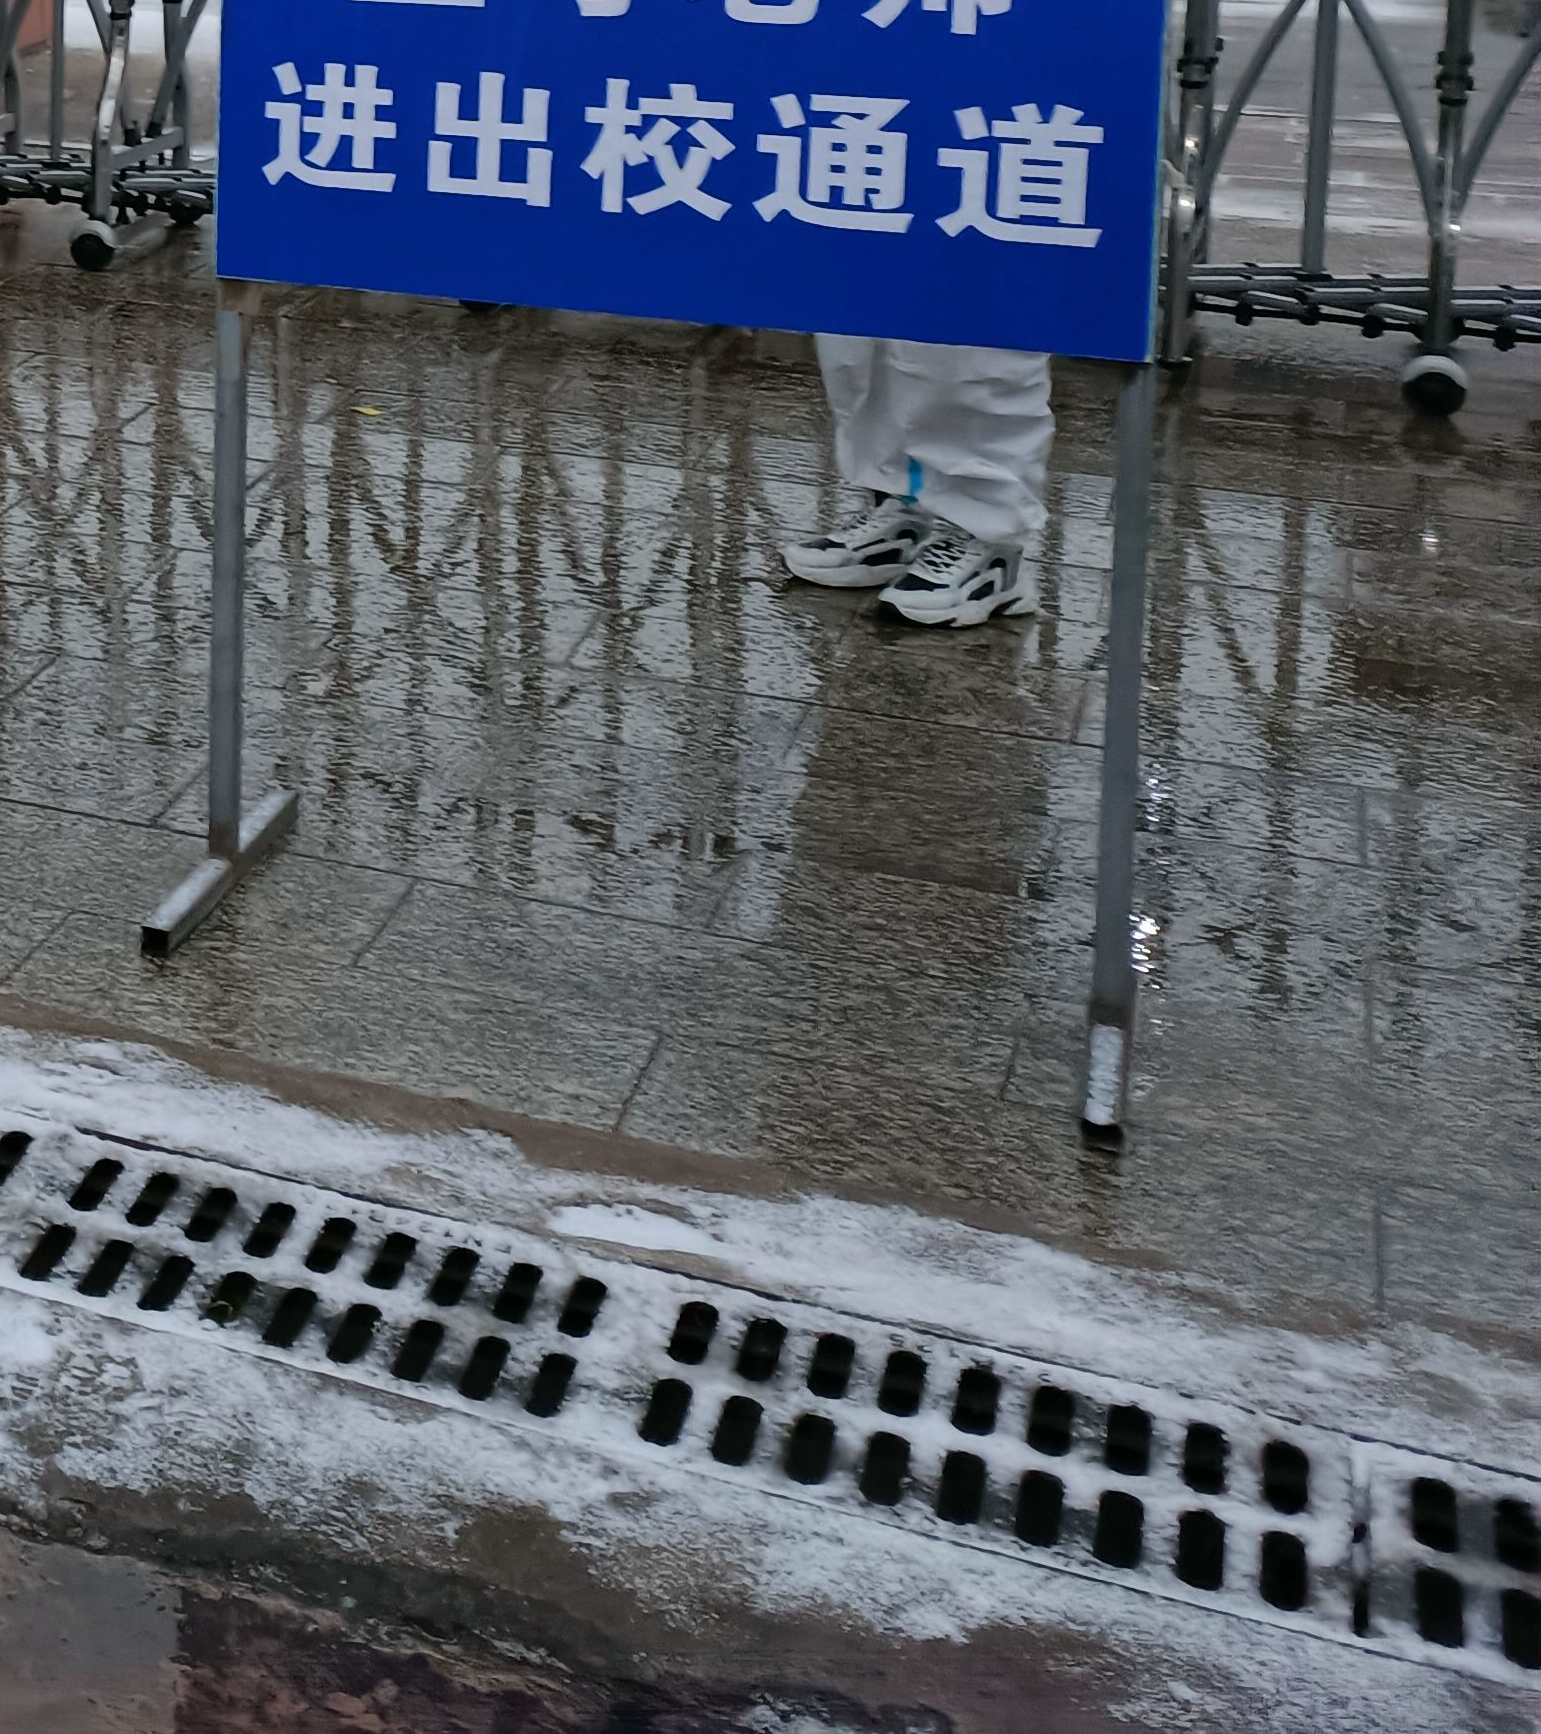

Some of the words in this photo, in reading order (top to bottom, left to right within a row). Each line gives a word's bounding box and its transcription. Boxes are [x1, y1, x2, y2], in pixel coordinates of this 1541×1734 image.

[262, 61, 1104, 248] 进出校通道
